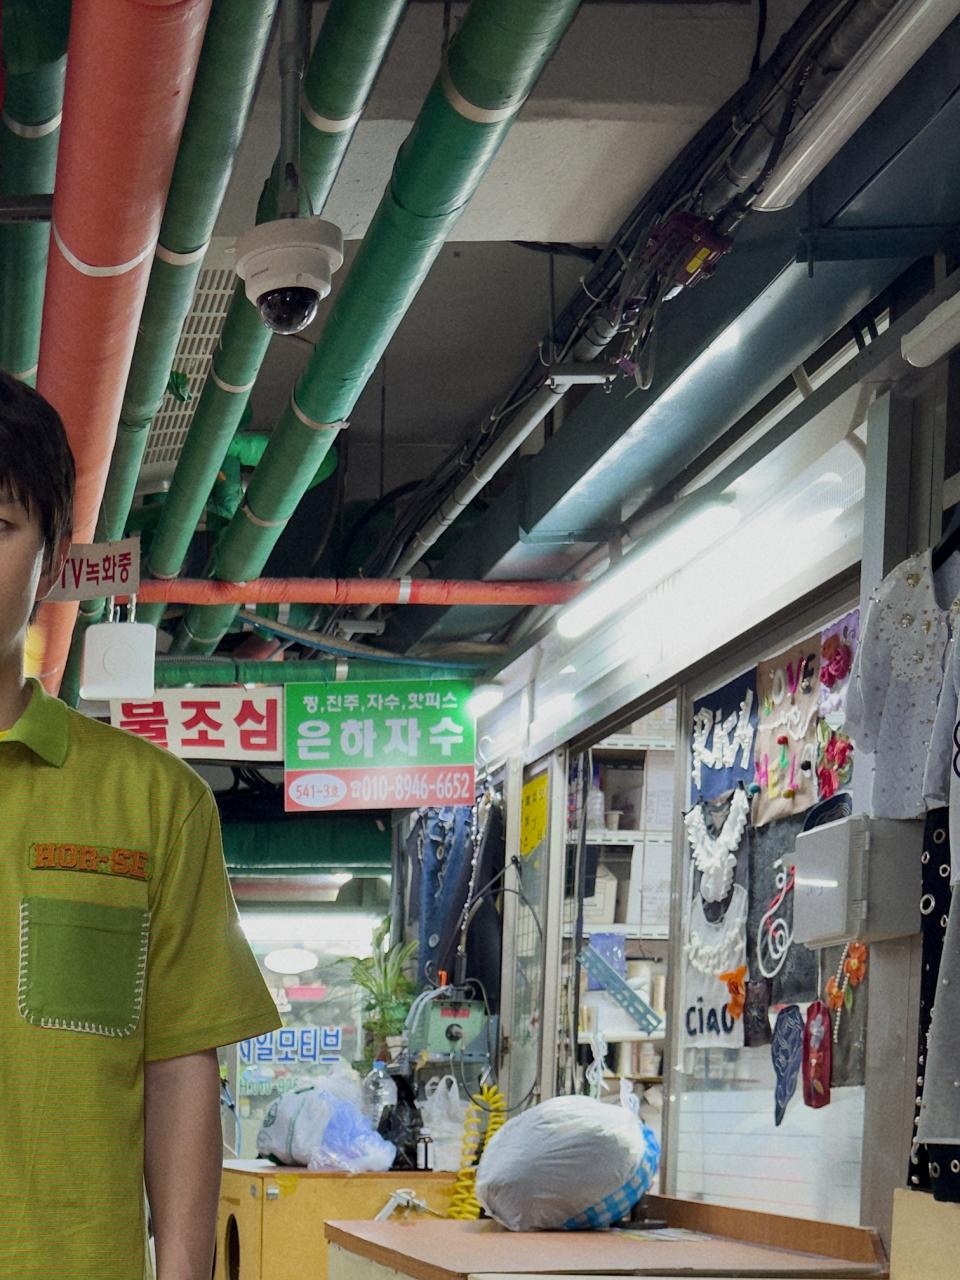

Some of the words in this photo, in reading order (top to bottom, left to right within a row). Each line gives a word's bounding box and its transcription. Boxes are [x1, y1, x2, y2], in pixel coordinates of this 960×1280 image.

[120, 698, 278, 752] 불조심
[296, 716, 464, 761] 은하자수
[362, 772, 470, 801] 010-8946-6652
